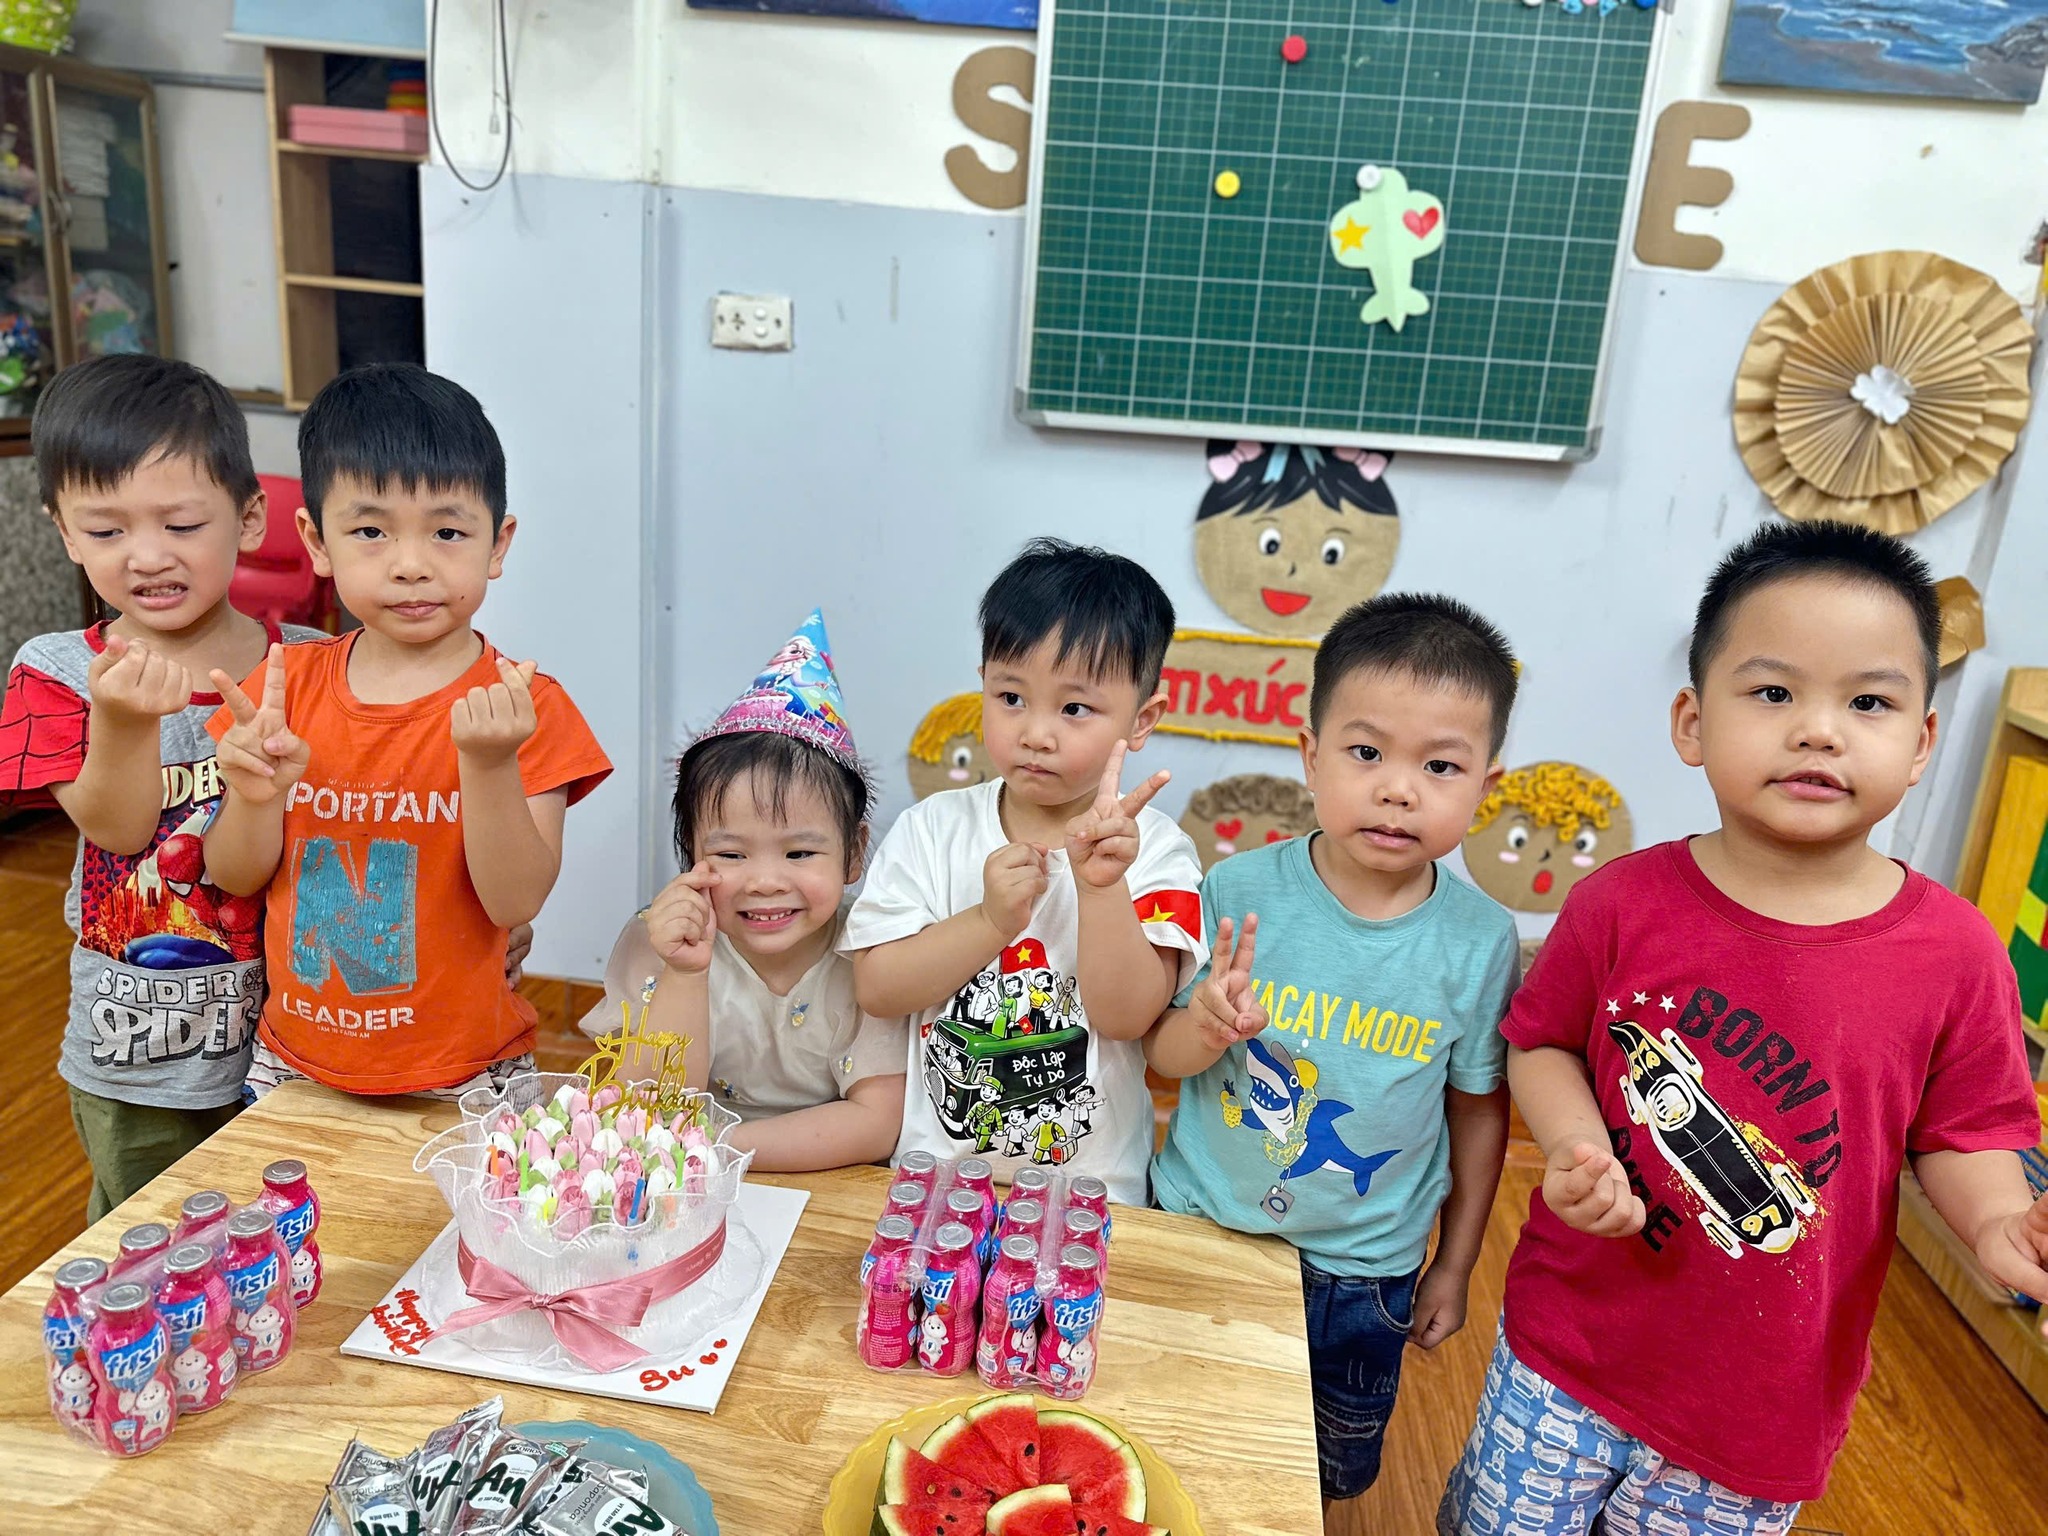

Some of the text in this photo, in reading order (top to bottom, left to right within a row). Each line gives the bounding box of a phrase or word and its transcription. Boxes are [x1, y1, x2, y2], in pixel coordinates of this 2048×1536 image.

[944, 46, 1036, 209] S
[1634, 100, 1751, 271] E
[287, 835, 418, 996] N
[95, 967, 239, 1004] SPIDER
[282, 992, 416, 1031] LEADER
[1251, 979, 1443, 1064] ACAY MODE
[1676, 985, 1832, 1115] BORN
[1740, 1203, 1783, 1237] 97
[640, 1365, 695, 1391] Su
[465, 1462, 528, 1509] An
